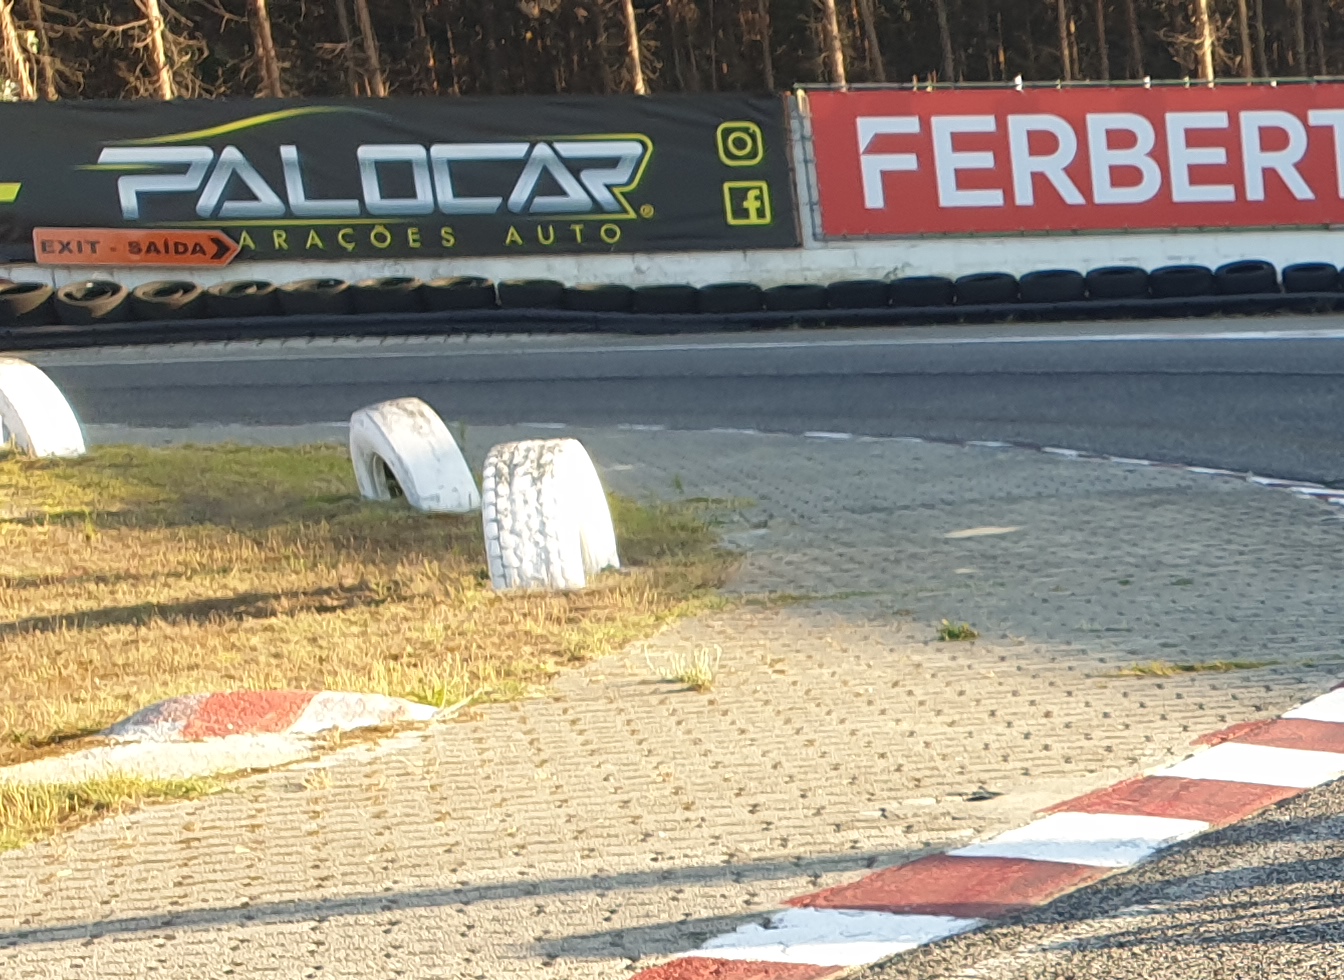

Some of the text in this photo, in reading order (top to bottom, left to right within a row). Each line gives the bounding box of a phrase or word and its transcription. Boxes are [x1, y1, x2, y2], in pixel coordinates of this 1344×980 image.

[97, 141, 645, 220] PALOCAR
[41, 239, 100, 255] EXIT
[127, 236, 207, 256] SAÍDA
[238, 222, 622, 252] ARAÇÕES AUTO
